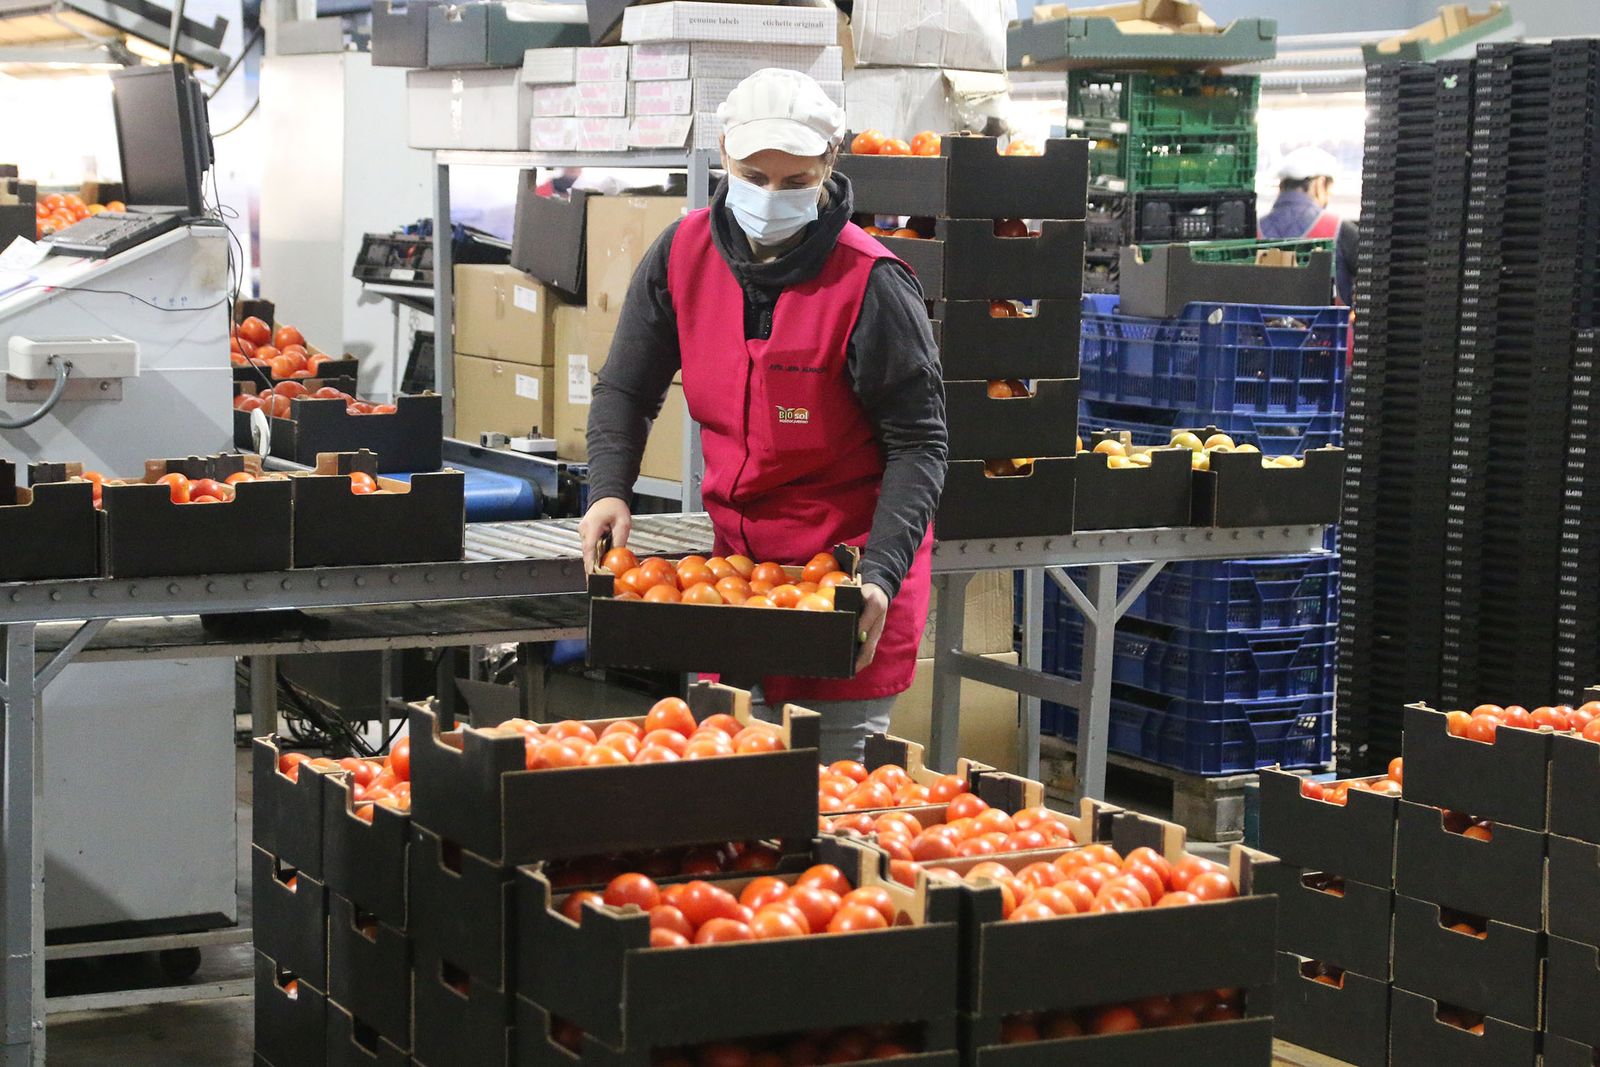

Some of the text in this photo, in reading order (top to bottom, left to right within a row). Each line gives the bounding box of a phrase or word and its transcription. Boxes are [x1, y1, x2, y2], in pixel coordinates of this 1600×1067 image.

[689, 16, 739, 25] genuine labels
[762, 19, 824, 28] etichette originali
